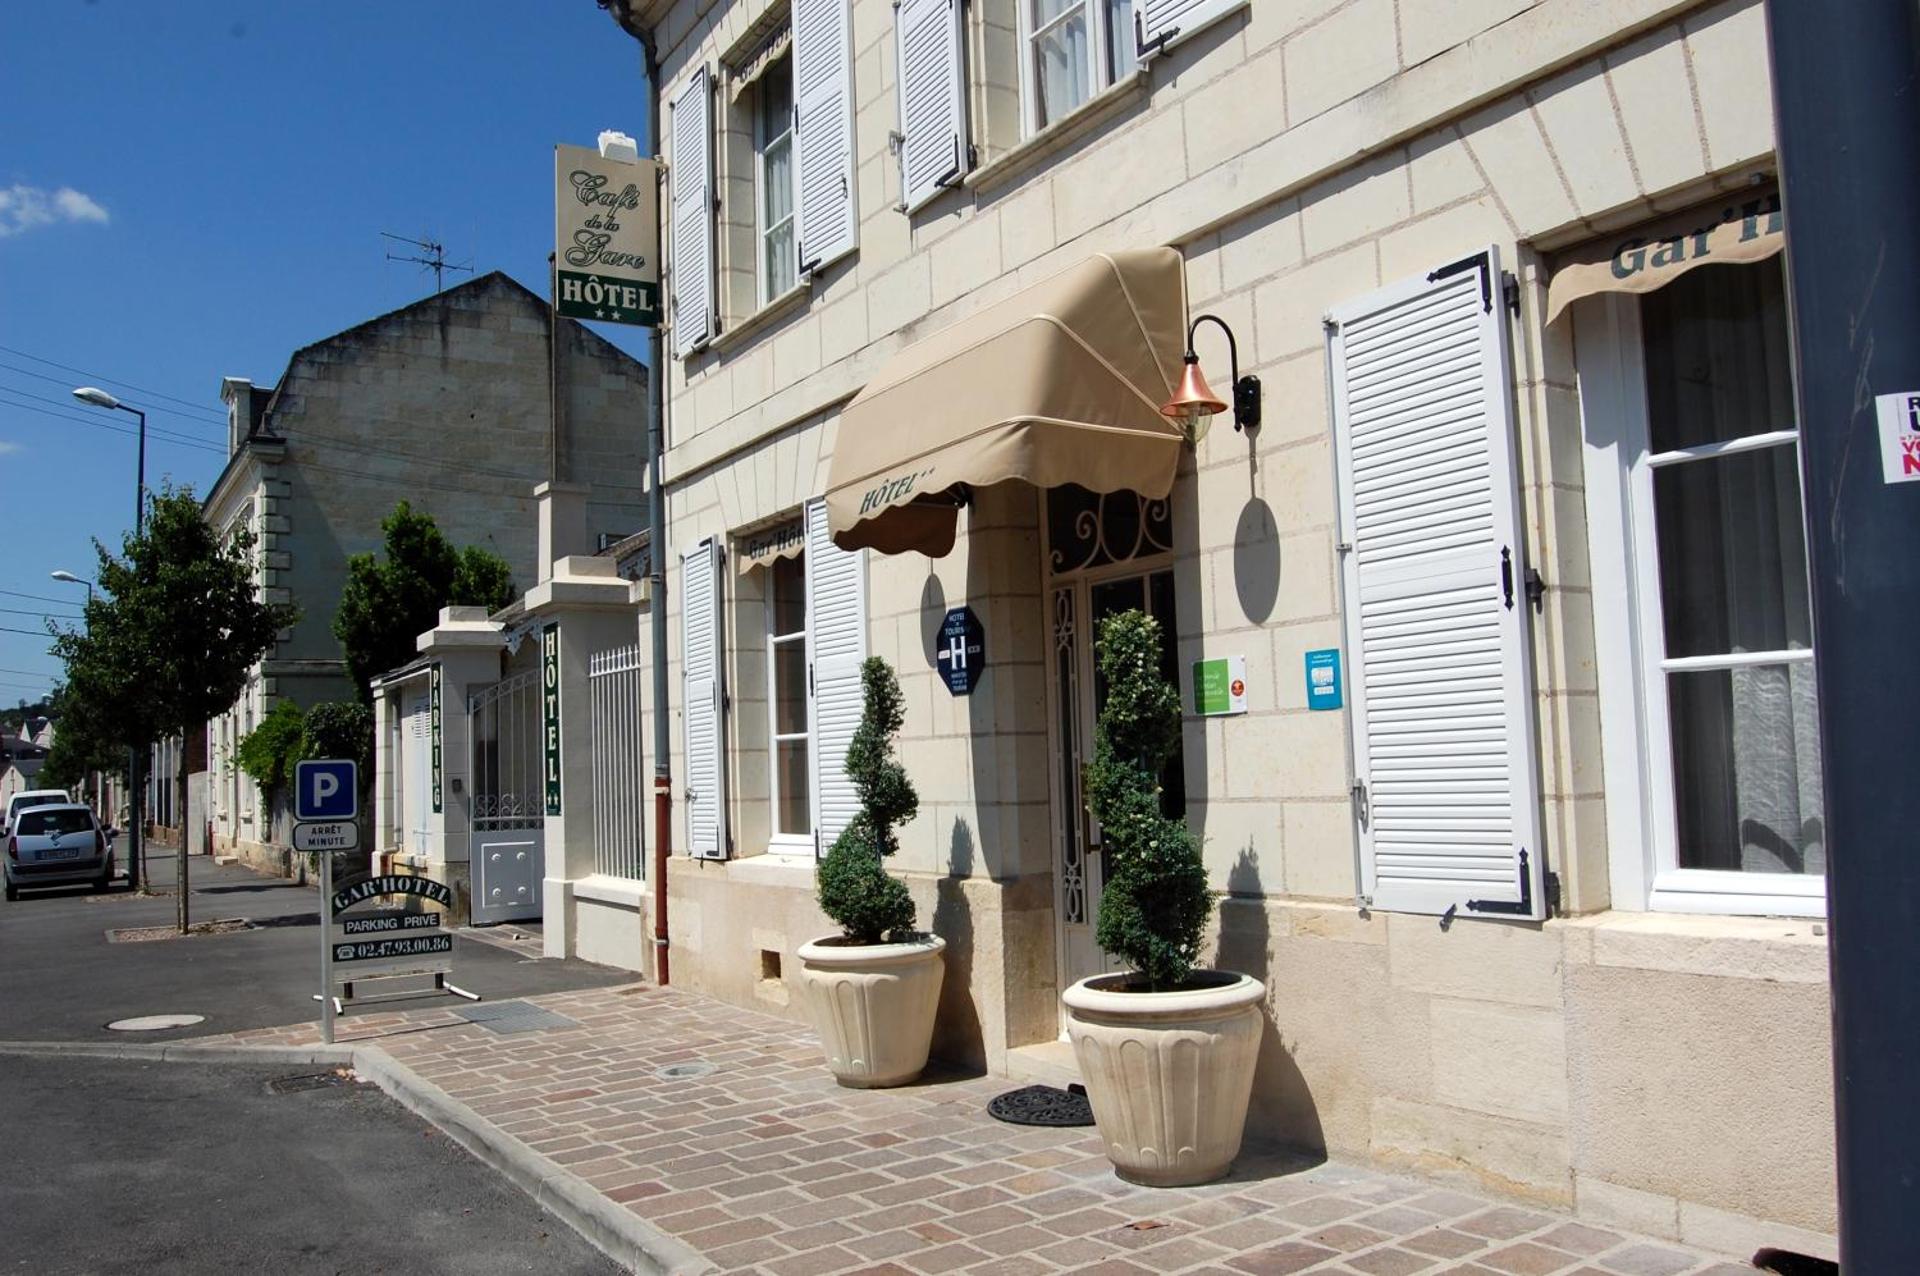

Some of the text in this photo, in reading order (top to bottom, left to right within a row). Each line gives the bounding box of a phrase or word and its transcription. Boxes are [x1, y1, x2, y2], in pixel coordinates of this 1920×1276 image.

[569, 170, 641, 217] Café
[584, 214, 620, 232] de la
[565, 229, 645, 269] Gare
[563, 276, 653, 312] HÔTEL
[858, 472, 918, 514] HÔTEL
[950, 636, 967, 669] H
[545, 632, 557, 781] HÔTEL
[432, 670, 441, 805] PARKING
[313, 772, 339, 808] P
[308, 837, 345, 846] MINUTE
[311, 825, 342, 834] ARRÊT
[335, 877, 449, 908] GAR'HOTEL
[346, 918, 398, 932] PARKING
[358, 937, 449, 957] 02.47.93.00.86
